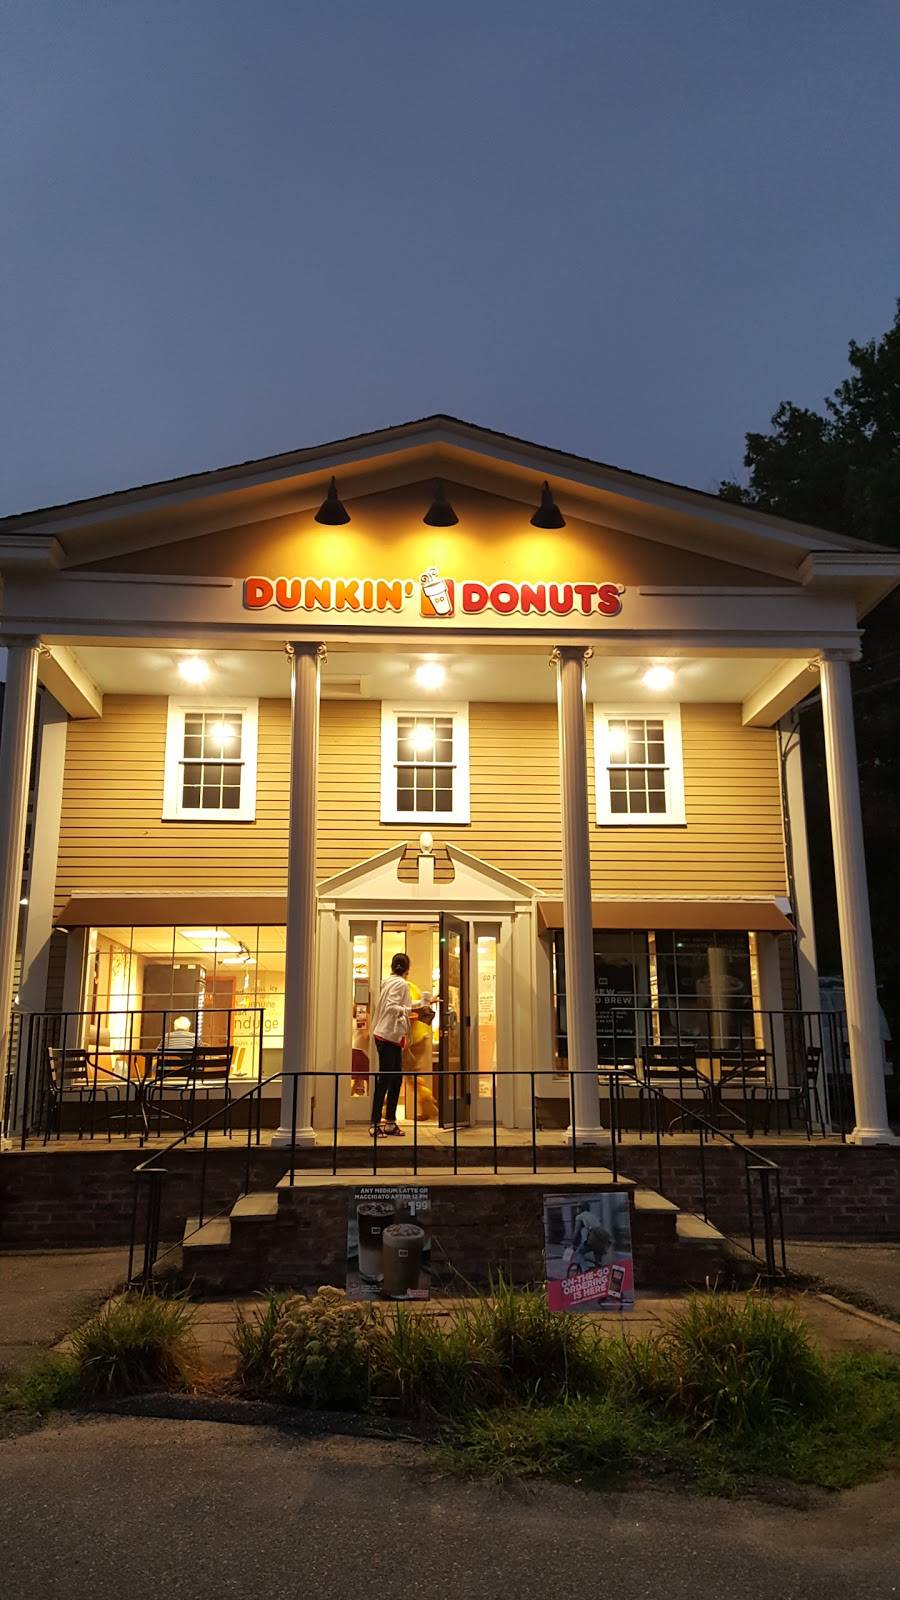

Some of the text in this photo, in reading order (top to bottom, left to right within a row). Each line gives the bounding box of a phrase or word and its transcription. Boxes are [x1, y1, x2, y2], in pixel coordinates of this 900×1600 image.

[244, 577, 624, 615] DUNKIN' DONUTS
[561, 1267, 609, 1288] ON-THE-GO
[563, 1275, 608, 1295] ORDERING
[573, 1291, 582, 1300] IS
[583, 1283, 607, 1297] HERE
